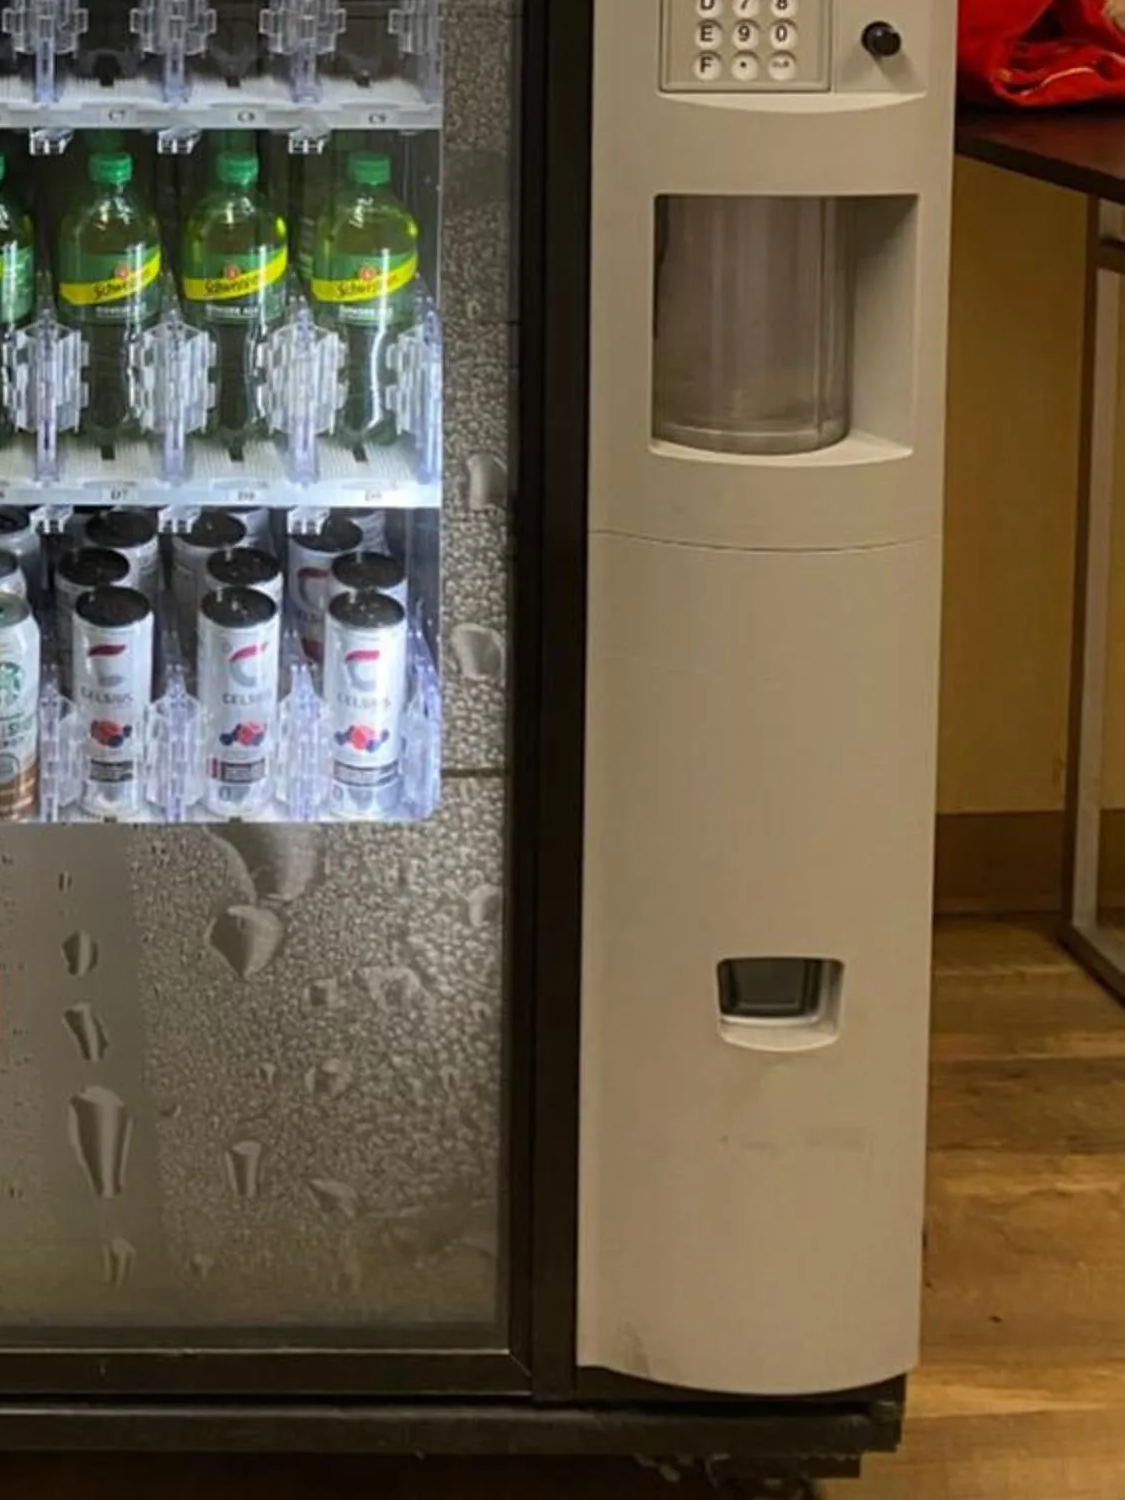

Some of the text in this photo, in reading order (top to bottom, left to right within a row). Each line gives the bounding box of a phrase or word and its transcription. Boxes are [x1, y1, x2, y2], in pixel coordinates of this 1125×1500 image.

[700, 25, 713, 41] E
[738, 25, 750, 41] 9
[701, 57, 713, 72] F
